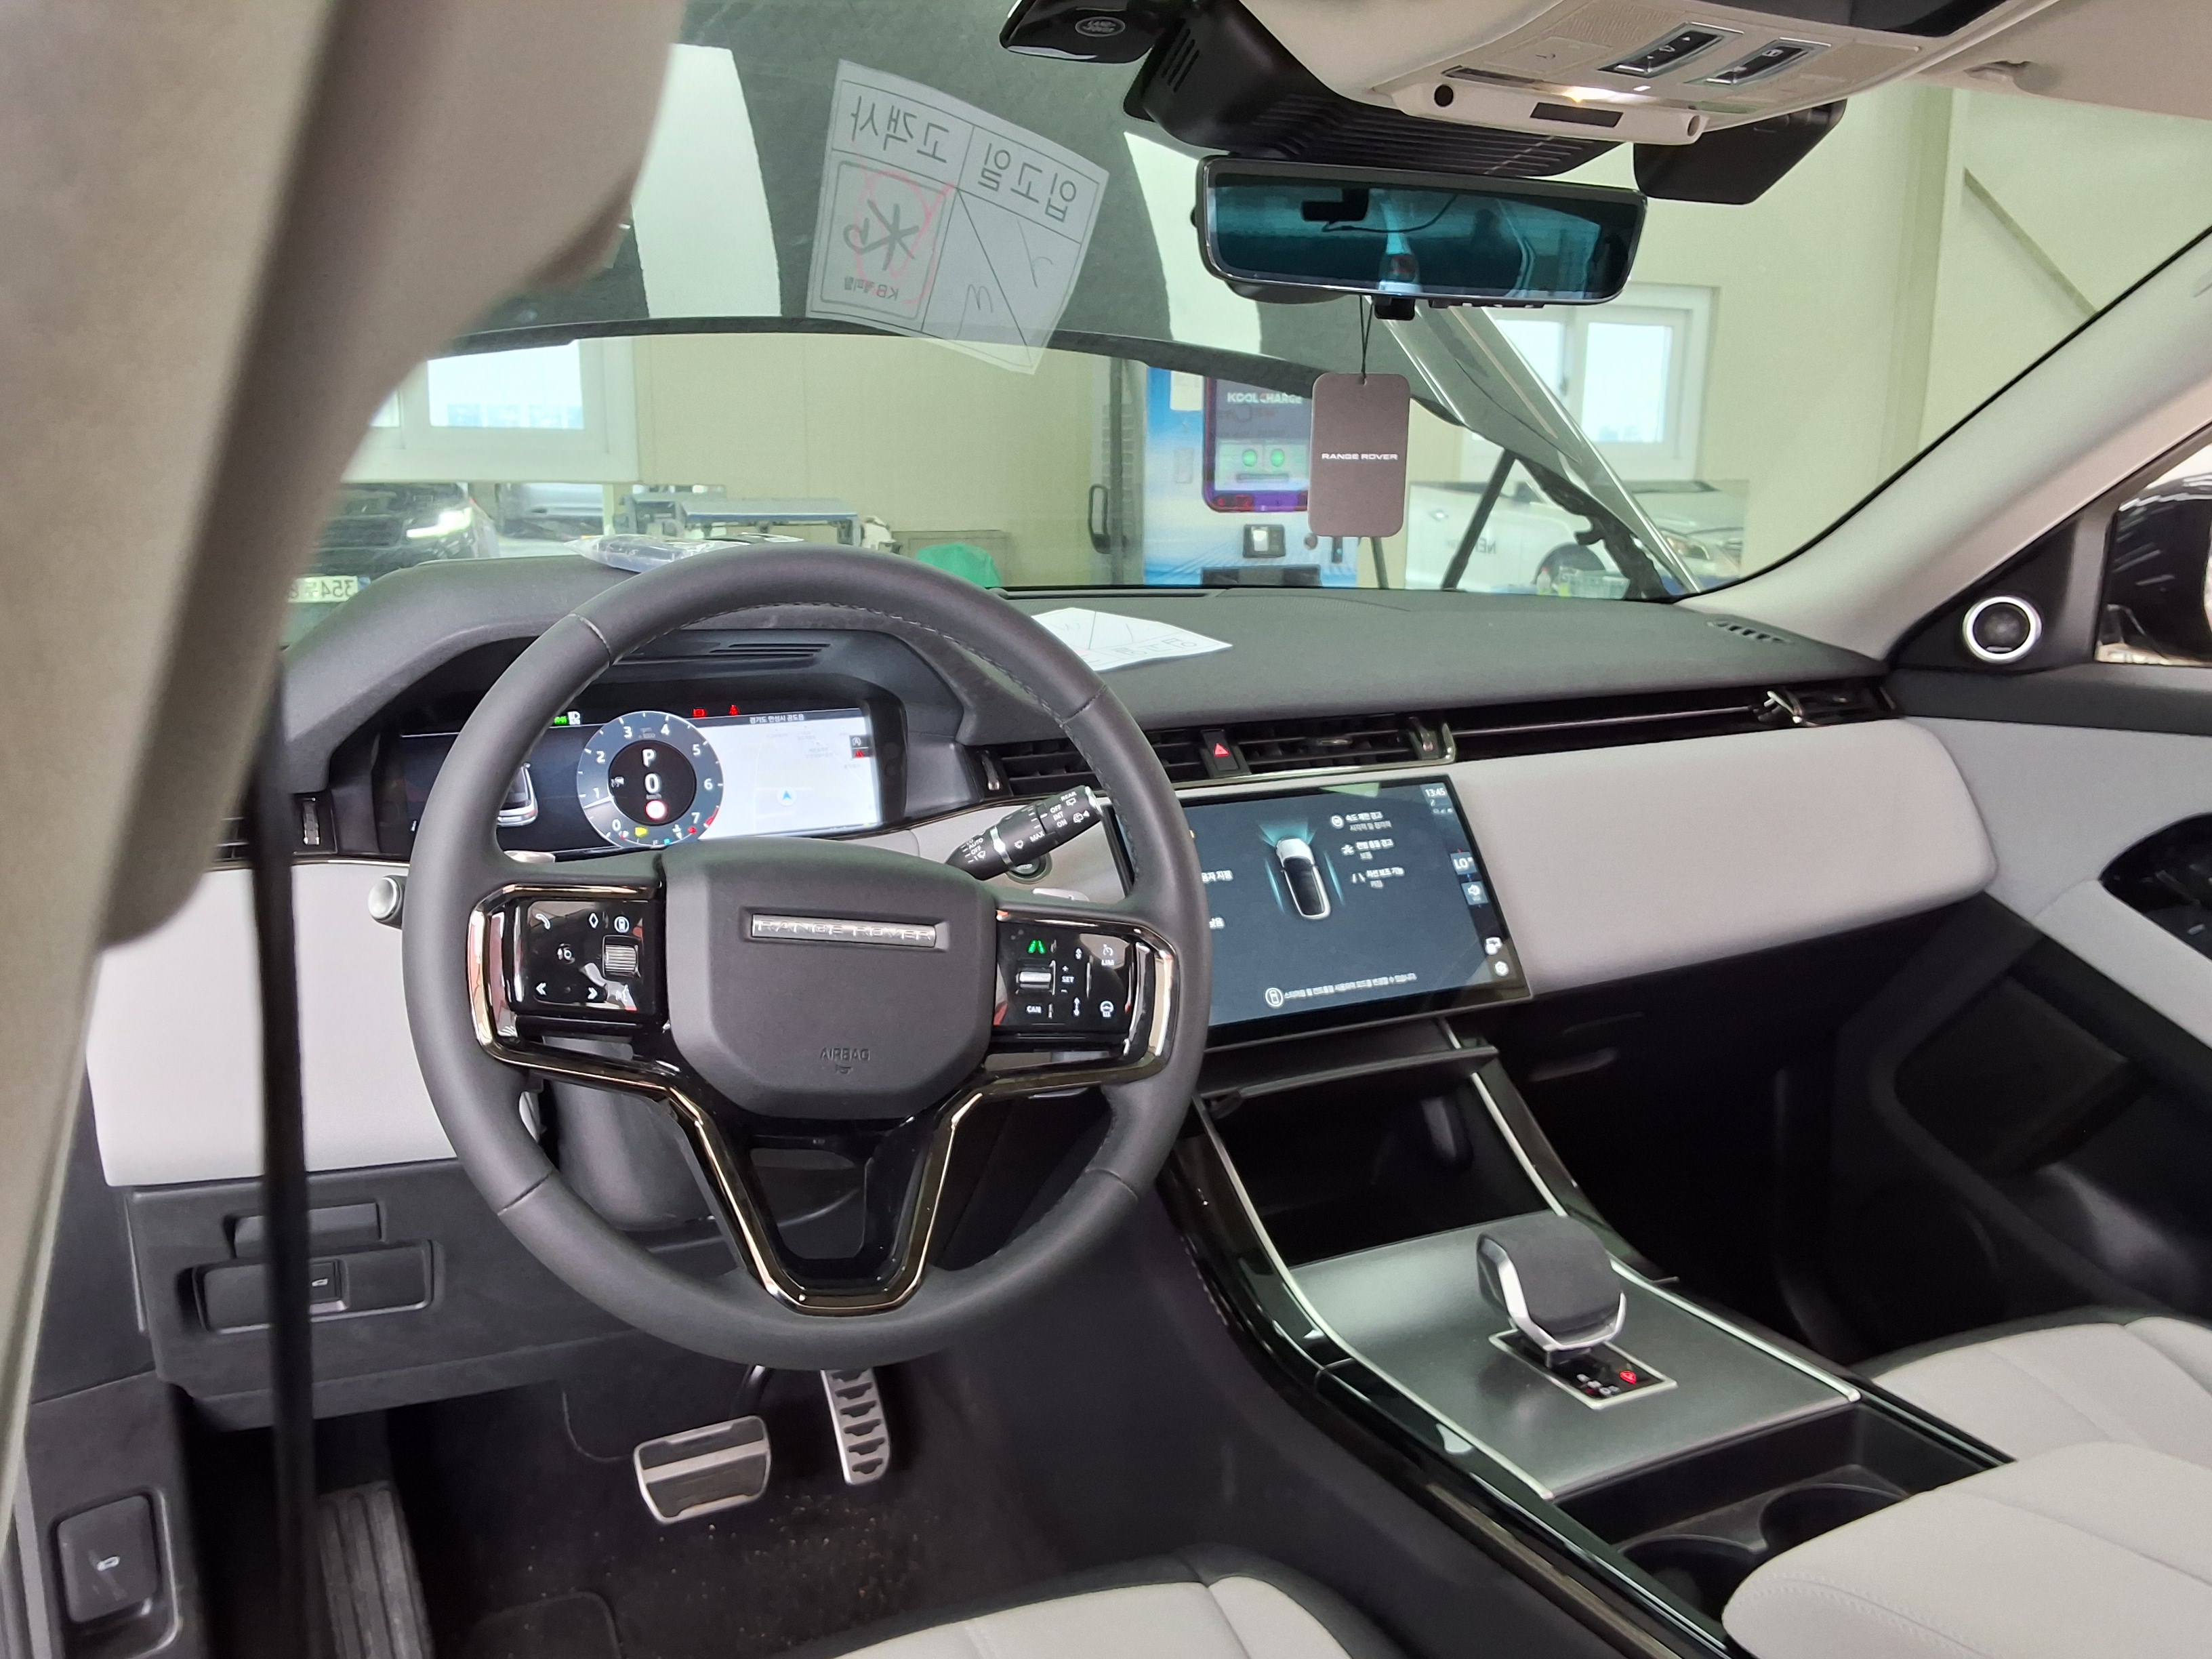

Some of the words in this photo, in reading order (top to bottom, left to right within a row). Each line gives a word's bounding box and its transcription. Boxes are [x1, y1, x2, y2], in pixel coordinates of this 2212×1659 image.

[1360, 453, 1398, 461] ROVER
[623, 726, 633, 738] 3
[660, 724, 670, 736] 4
[692, 744, 701, 756] 5
[596, 750, 606, 763] 2
[642, 748, 657, 768] P
[644, 773, 661, 794] 0
[703, 778, 713, 790] 6
[593, 787, 600, 799] 1
[1061, 791, 1077, 802] REAR
[1425, 787, 1446, 798] 13:45
[1050, 804, 1062, 814] OFF
[691, 812, 700, 823] 7
[1052, 811, 1064, 821] INT
[612, 819, 621, 832] 0
[1056, 819, 1068, 828] ON
[1029, 830, 1046, 842] MAX
[968, 837, 984, 850] AUTO
[970, 845, 982, 855] OFF
[757, 920, 844, 935] RANGE
[853, 926, 931, 941] ROVER
[1026, 1006, 1042, 1014] CAN
[820, 1048, 870, 1061] AIRBAG
